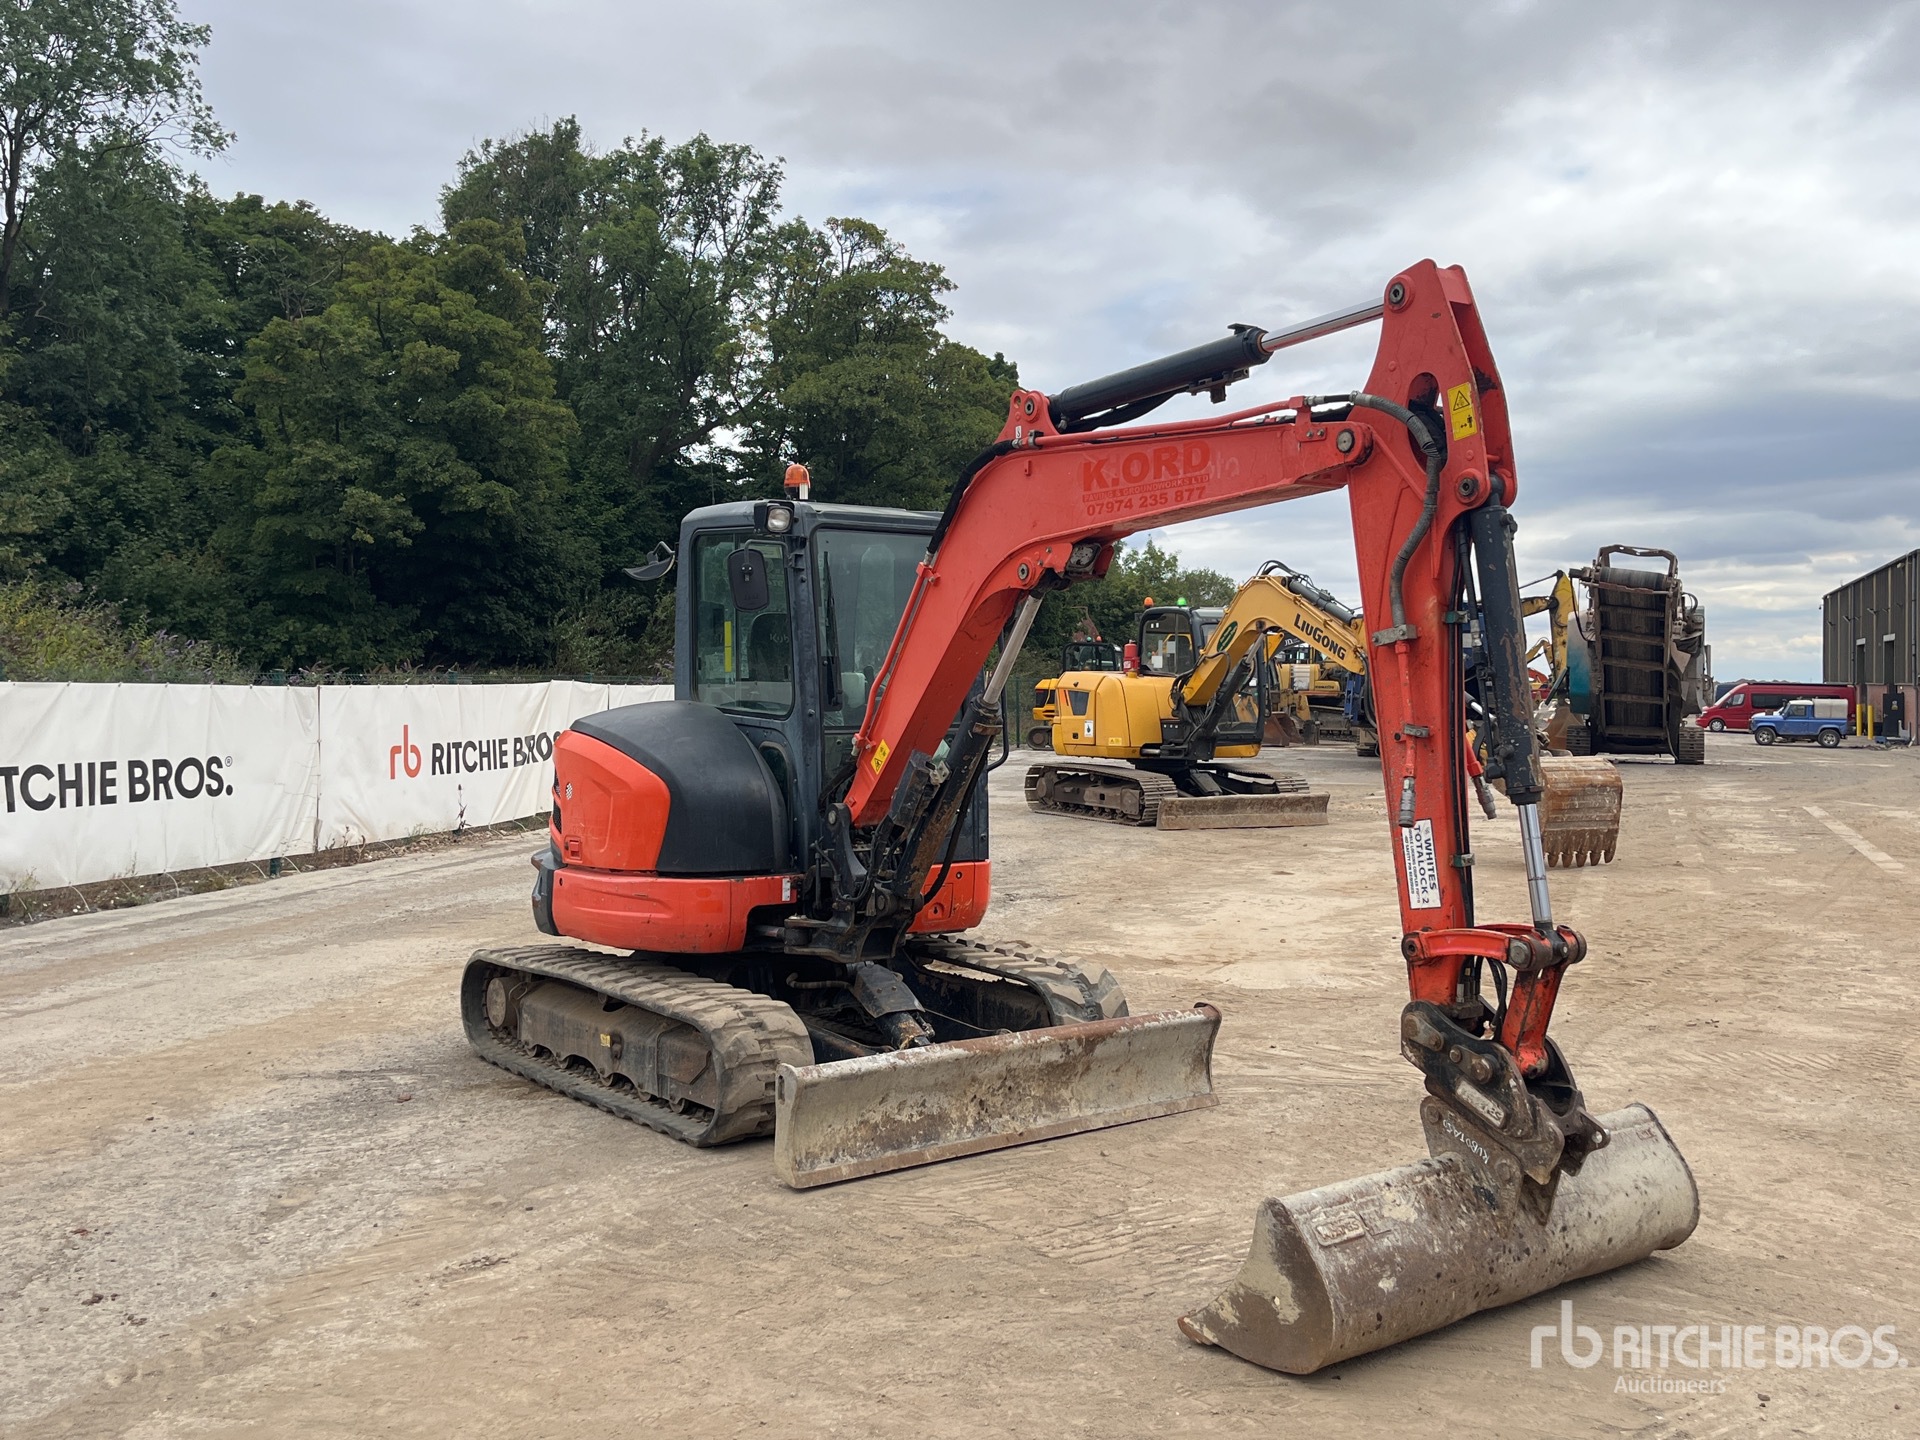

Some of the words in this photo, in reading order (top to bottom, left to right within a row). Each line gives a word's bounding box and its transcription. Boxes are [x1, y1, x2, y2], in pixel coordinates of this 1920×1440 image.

[1083, 440, 1211, 491] K.ORD
[1124, 479, 1189, 496] GROUNDWORKS
[1191, 475, 1209, 484] LTD
[1086, 499, 1134, 517] 07974
[1139, 493, 1169, 508] 235
[1175, 486, 1207, 503] 877
[431, 738, 509, 776] RITCHIE
[1414, 825, 1428, 894] TOTALOCK
[1421, 896, 1430, 904] 2
[1424, 838, 1436, 890] WHITES
